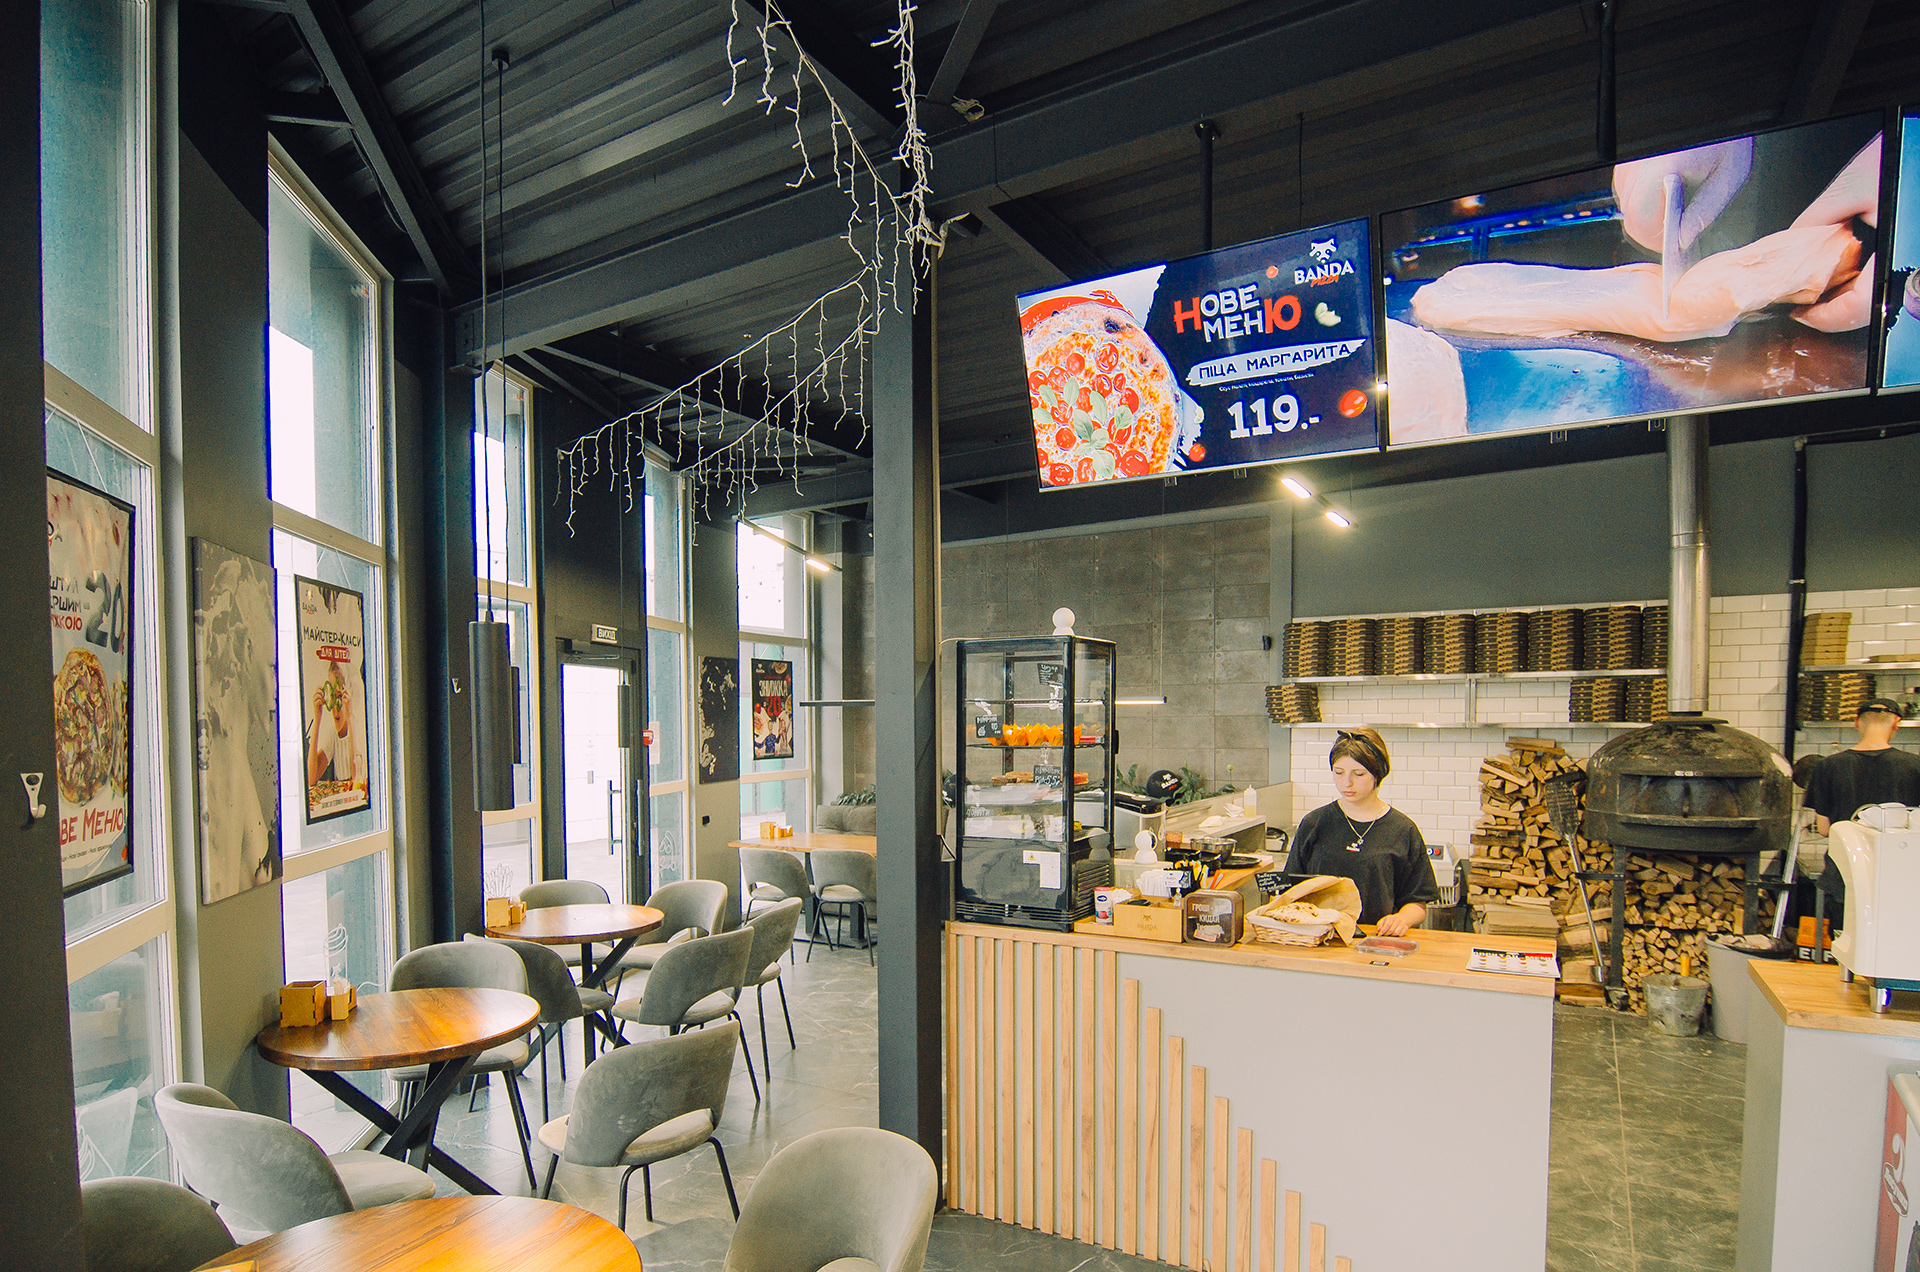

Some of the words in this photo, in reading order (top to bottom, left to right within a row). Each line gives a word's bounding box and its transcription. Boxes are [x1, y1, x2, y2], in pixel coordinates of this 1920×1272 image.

[1294, 260, 1355, 285] BANDA
[1310, 274, 1340, 288] PIZZA
[1173, 284, 1261, 334] НОВЕ
[1203, 295, 1302, 343] МЕНЮ
[1199, 363, 1238, 380] ПІЦА
[1246, 343, 1351, 372] МАРГАРИТА
[303, 626, 361, 647] МАЙСТЕР-КЛАСИ
[598, 628, 616, 641] ВИХІД
[758, 680, 788, 697] ЗНИЖКА
